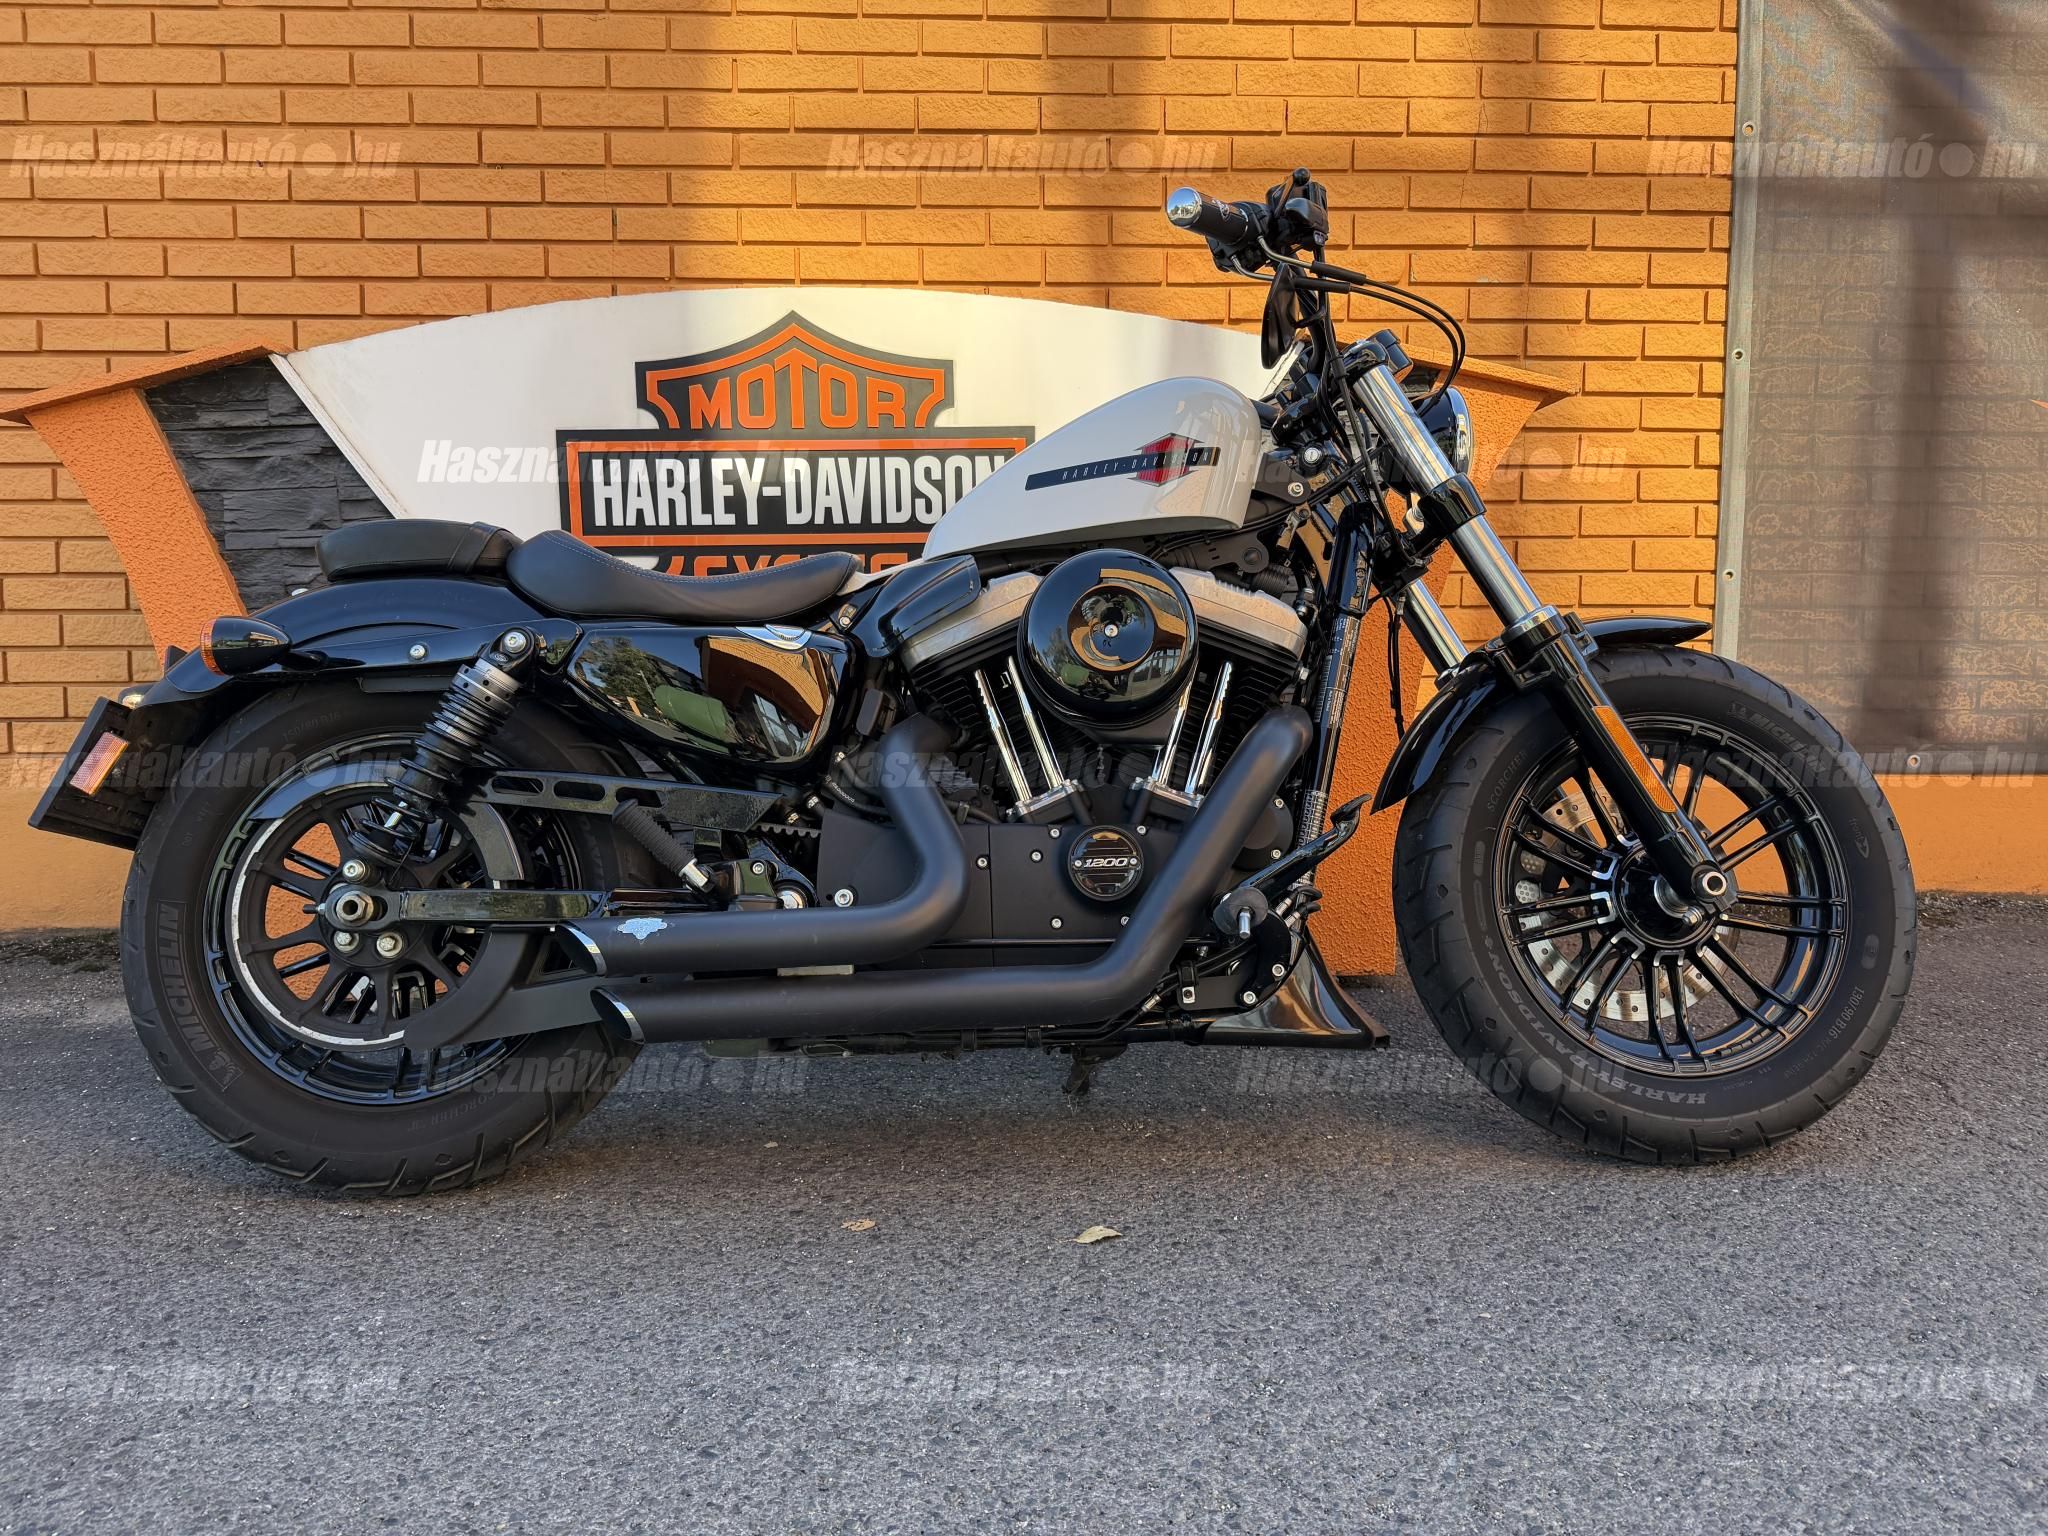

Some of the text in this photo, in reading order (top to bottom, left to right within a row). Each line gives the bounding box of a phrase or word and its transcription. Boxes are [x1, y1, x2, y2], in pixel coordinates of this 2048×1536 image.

[688, 347, 906, 430] MOTOR
[1062, 451, 1209, 481] HARLEY-DAVIDON
[1083, 857, 1129, 868] 1200
[157, 903, 216, 1053] MICHELIN
[1843, 986, 1865, 1020] 130/90
